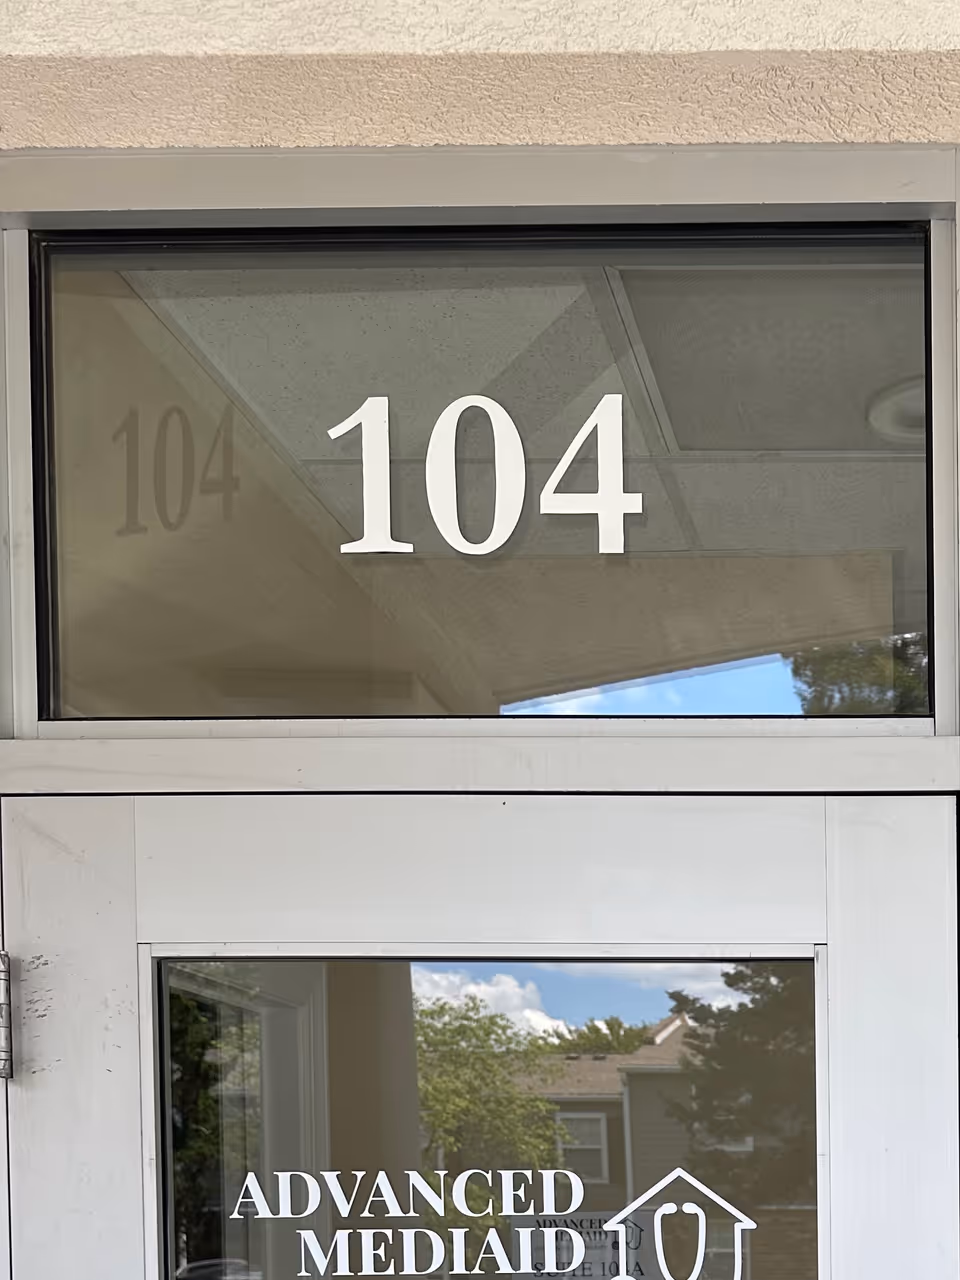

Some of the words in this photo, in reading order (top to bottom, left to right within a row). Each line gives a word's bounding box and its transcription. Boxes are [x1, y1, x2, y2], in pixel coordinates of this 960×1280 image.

[327, 394, 642, 554] 104
[230, 1169, 584, 1219] ADVANCED
[296, 1227, 586, 1276] MEDIAID
